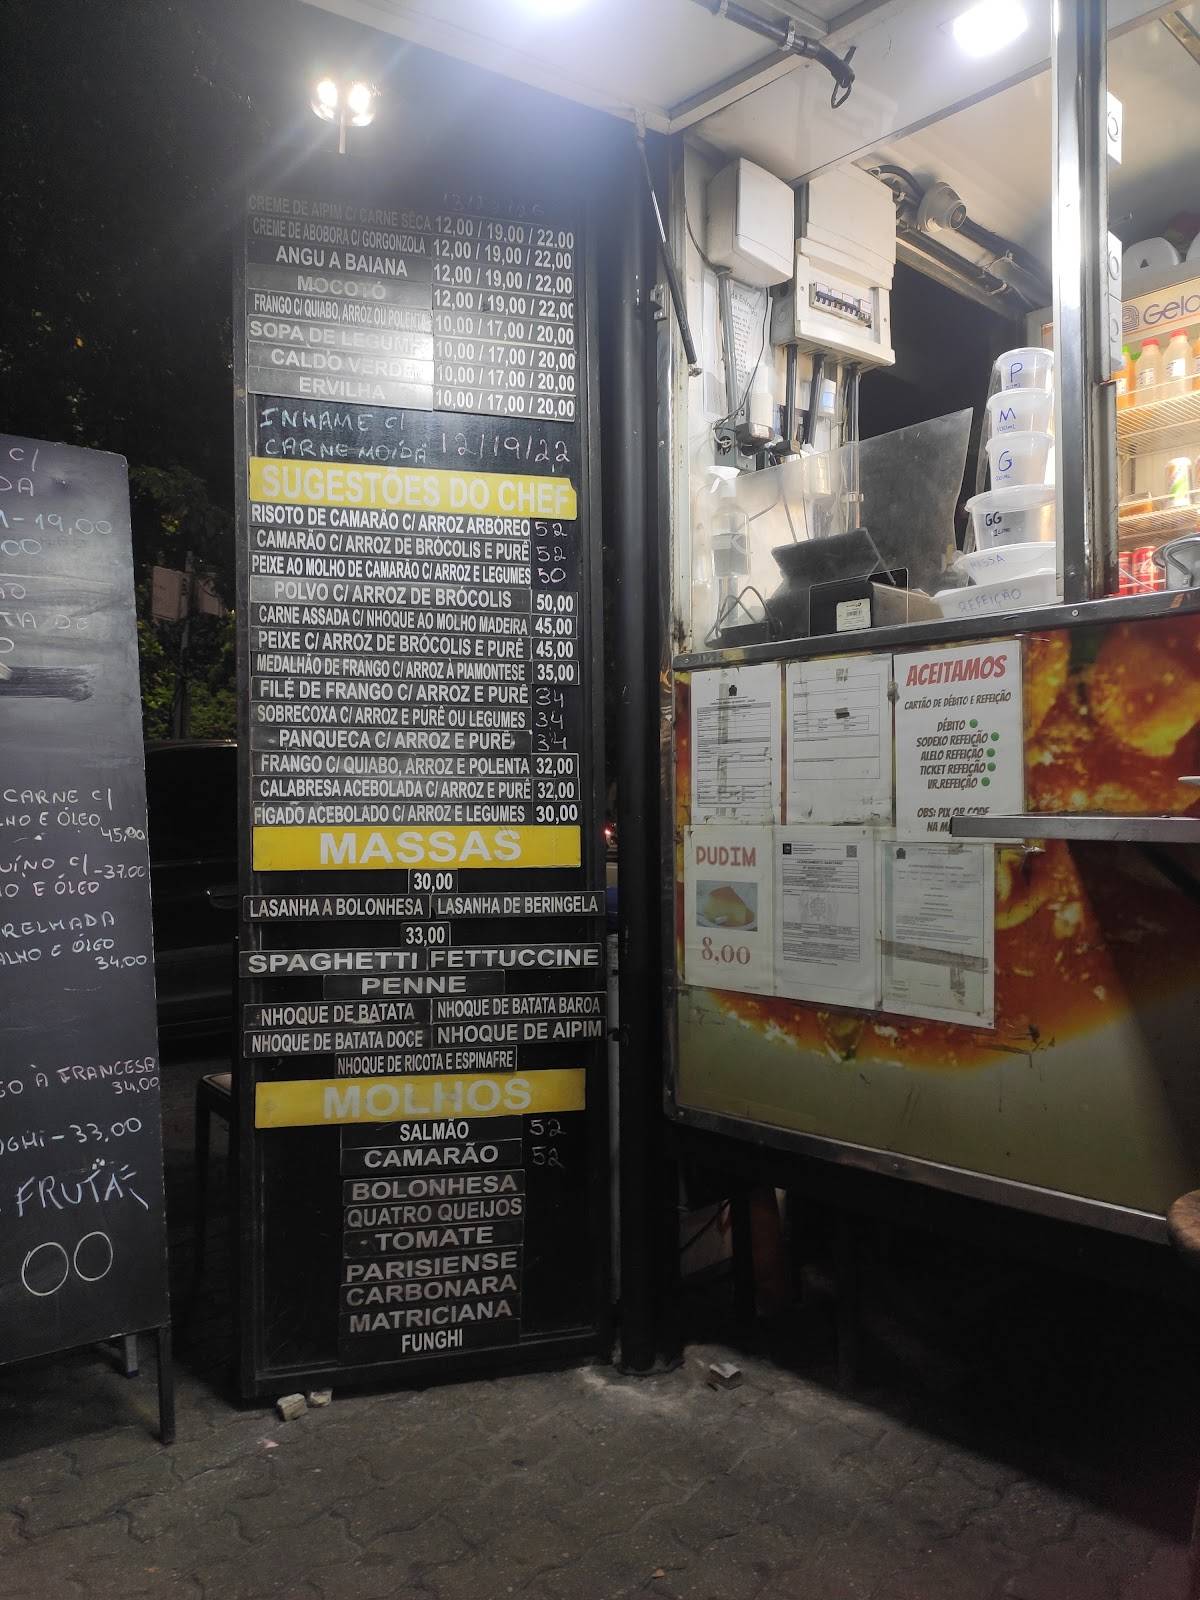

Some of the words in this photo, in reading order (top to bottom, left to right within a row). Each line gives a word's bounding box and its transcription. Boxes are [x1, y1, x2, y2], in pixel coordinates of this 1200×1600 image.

[276, 245, 325, 268] ANGU
[327, 251, 341, 270] A
[344, 252, 407, 277] BAIANA
[434, 264, 471, 287] 12,00
[485, 268, 523, 290] 19,00
[535, 273, 573, 295] 22,00
[271, 348, 344, 372] CALDO
[1010, 362, 1022, 384] P
[299, 376, 385, 400] ERVILHA
[436, 393, 474, 411] 10,00
[487, 396, 525, 418] 17,00
[537, 399, 575, 419] 20,00
[1000, 408, 1016, 422] M
[264, 437, 348, 457] CARNE
[998, 450, 1014, 472] G
[261, 464, 441, 508] SUGESTÕES
[449, 477, 491, 510] DO
[498, 480, 570, 514] CHEF
[251, 505, 304, 525] RISOTO
[307, 508, 326, 526] DE
[329, 505, 399, 530] CAMARÃO
[401, 513, 415, 531] C/
[417, 514, 464, 534] ARROZ
[466, 513, 530, 537] ARBÓREO
[535, 521, 568, 537] 52
[984, 512, 1002, 526] GG
[274, 581, 329, 602] POLVO
[331, 584, 349, 603] C/
[351, 585, 407, 605] ARROZ
[410, 587, 432, 606] DE
[435, 585, 512, 608] BRÓCOLIS
[536, 593, 574, 615] 50,00
[258, 605, 299, 624] CARNE
[302, 607, 349, 626] ASSADA
[352, 609, 363, 627] C/
[366, 610, 414, 630] NHOQUE
[417, 612, 433, 630] AO
[436, 613, 476, 632] MOLHO
[479, 615, 528, 634] MADEIRA
[535, 616, 573, 638] 45,00
[256, 654, 321, 676] MEDALHÃO
[324, 659, 339, 676] DE
[342, 659, 390, 677] FRANGO
[392, 661, 403, 678] C/
[405, 661, 443, 679] ARROZ
[446, 659, 454, 679] À
[456, 663, 525, 680] PIAMONTESE
[537, 664, 575, 684] 35,00
[906, 654, 1008, 687] ACEITAMOS
[904, 696, 932, 710] CARTÃO
[932, 697, 942, 708] DE
[943, 694, 969, 708] DÉBITO
[970, 694, 975, 705] E
[975, 689, 1012, 705] REFEIÇÃO
[937, 717, 966, 732] DÉBITO
[279, 731, 371, 750] PANQUECA
[374, 731, 391, 749] C/
[393, 731, 451, 749] ARROZ
[453, 732, 465, 749] E
[468, 728, 511, 750] PURÊ
[916, 735, 948, 748] SODEXO
[949, 729, 988, 746] REFEIÇÃO
[920, 748, 944, 761] ALELO
[945, 744, 984, 762] REFEIÇÃO
[260, 756, 322, 773] FRANGO
[325, 756, 340, 773] C/
[342, 756, 401, 776] QUIABO,
[404, 757, 453, 773] ARROZ
[456, 757, 466, 773] E
[468, 757, 529, 774] POLENTA
[536, 756, 574, 777] 32,00
[920, 764, 946, 776] TICKET
[947, 758, 986, 776] REFEIÇÃO
[3, 789, 79, 805] CARNE
[917, 807, 937, 818] OBS:
[937, 807, 951, 819] PIX
[319, 828, 522, 865] MASSAS
[695, 845, 757, 868] PUDIM
[413, 873, 453, 893] 30,00
[249, 899, 319, 917] LASANHA
[322, 899, 332, 917] A
[335, 898, 423, 916] BOLONHESA
[437, 898, 500, 916] LASANHA
[503, 897, 521, 914] DE
[524, 895, 598, 914] BERINGELA
[405, 927, 445, 946] 33,00
[248, 952, 417, 973] SPAGHETTI
[430, 948, 599, 969] FETTUCCINE
[361, 975, 467, 995] PENNE
[261, 1006, 330, 1028] NHOQUE
[332, 1005, 355, 1024] DE
[357, 1003, 415, 1023] BATATA
[437, 1000, 489, 1018] NHOQUE
[492, 999, 509, 1016] DE
[511, 998, 556, 1016] BATATA
[558, 997, 600, 1014] BAROA
[251, 1034, 310, 1053] NHOQUE
[313, 1033, 331, 1051] DE
[334, 1031, 383, 1050] BATATA
[386, 1030, 423, 1048] DOCE
[437, 1024, 519, 1046] NHOQUE
[522, 1023, 548, 1041] DE
[551, 1020, 602, 1040] AIPIM
[56, 1056, 156, 1084] FRANCESA
[337, 1056, 384, 1076] NHOQUE
[387, 1055, 401, 1073] DE
[404, 1054, 443, 1072] RICOTA
[445, 1054, 452, 1070] E
[455, 1051, 513, 1070] ESPINAFRE
[323, 1078, 532, 1120] MOLHOS
[399, 1117, 470, 1142] SALMÃO
[364, 1142, 499, 1169] CAMARÃO
[351, 1174, 518, 1201] BOLONHESA
[347, 1203, 433, 1229] QUATRO
[436, 1197, 522, 1223] QUEIJOS
[374, 1226, 494, 1252] TOMATE
[346, 1250, 518, 1284] PARISIENSE
[346, 1273, 518, 1307] CARBONARA
[349, 1299, 513, 1333] MATRICIANA
[401, 1328, 464, 1354] FUNGHI
